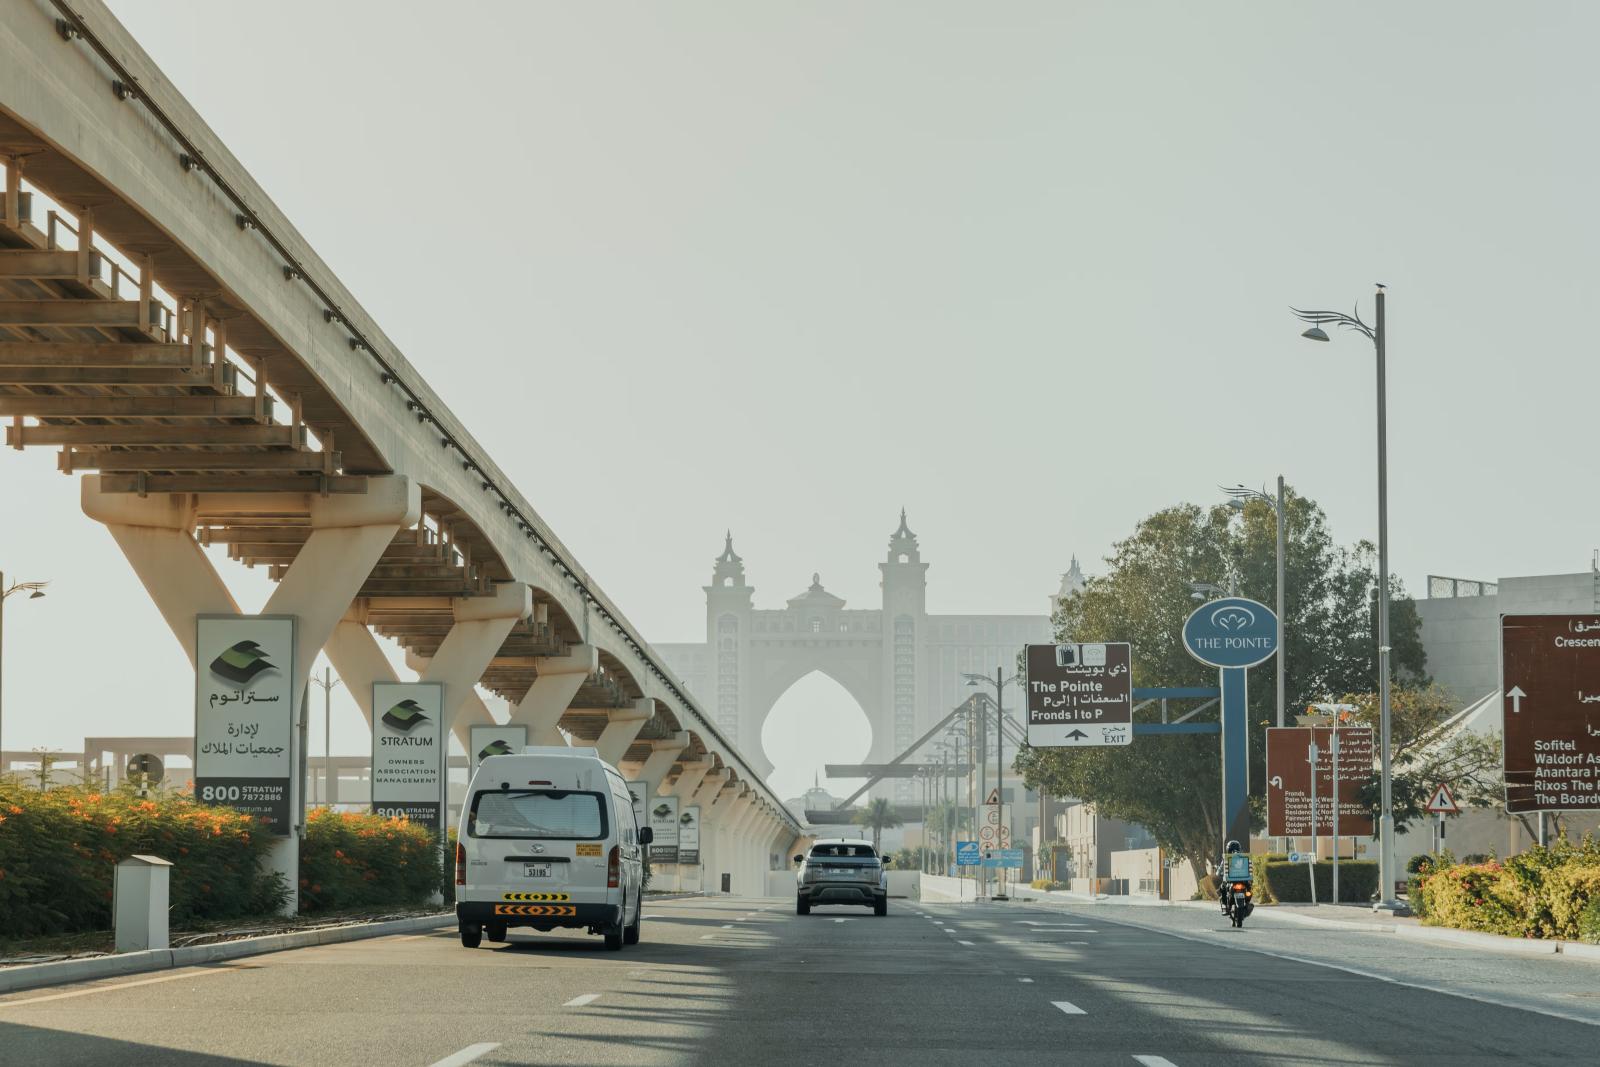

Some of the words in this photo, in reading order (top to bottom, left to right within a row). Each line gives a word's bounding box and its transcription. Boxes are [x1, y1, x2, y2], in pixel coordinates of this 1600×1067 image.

[1195, 637, 1221, 649] THE
[1225, 637, 1272, 649] POINTE
[1066, 664, 1105, 677] بوينت
[1108, 663, 1127, 677] ذي
[1031, 681, 1057, 693] The
[1060, 681, 1103, 692] Pointe
[209, 690, 279, 709] ستراتوم
[1080, 693, 1128, 703] السعفات
[1031, 709, 1071, 720] Fronds
[1081, 710, 1092, 719] to
[1095, 709, 1103, 719] P
[228, 722, 259, 739] لإدارة
[381, 736, 433, 746] STRATUM
[1104, 735, 1126, 744] EXIT
[201, 742, 232, 755] الملاك
[236, 742, 285, 758] جمعيات
[1534, 740, 1576, 751] Sofitel
[1534, 753, 1583, 764] Waldorf
[1535, 766, 1591, 777] Anantara
[1534, 780, 1568, 791] Rixos
[1571, 780, 1593, 791] The
[202, 786, 240, 801] 800
[242, 793, 282, 801] 7872886
[1534, 793, 1557, 804] The
[377, 808, 404, 819] 800
